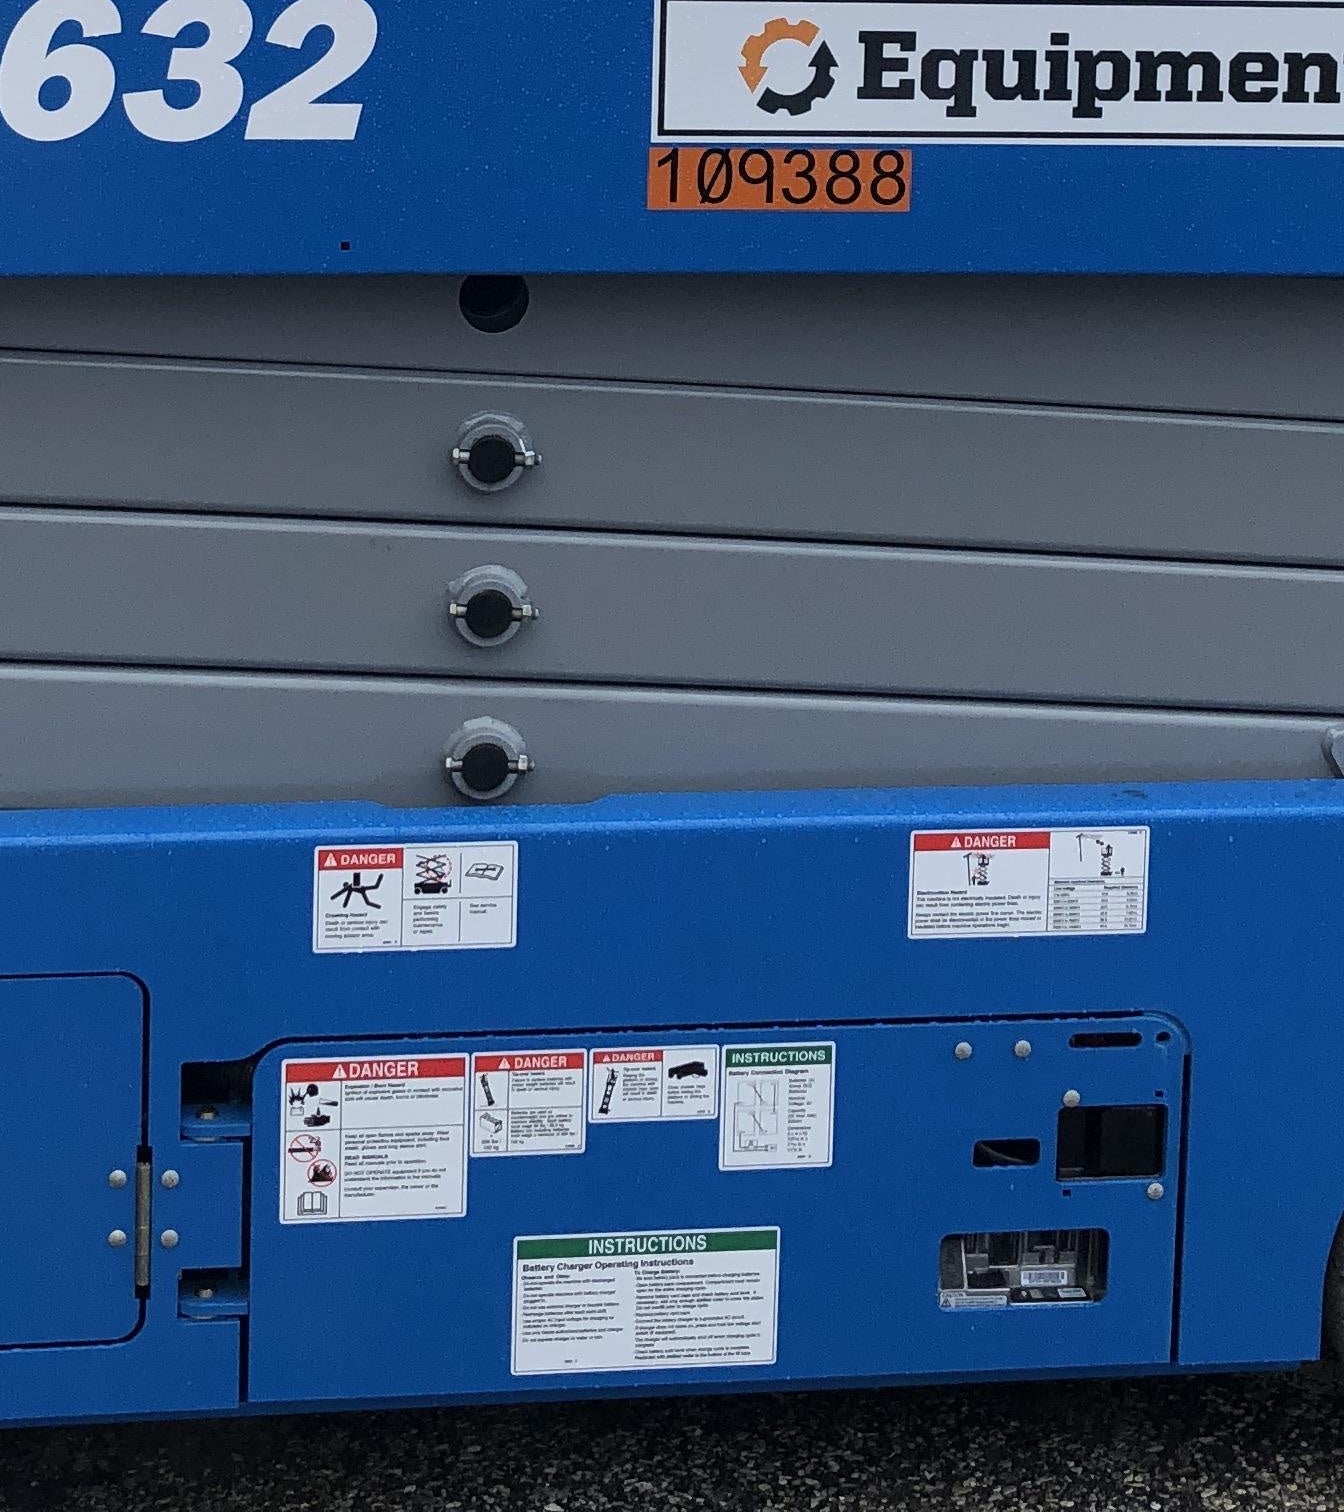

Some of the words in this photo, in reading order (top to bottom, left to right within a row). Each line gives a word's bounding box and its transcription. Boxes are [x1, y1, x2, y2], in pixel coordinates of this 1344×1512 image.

[655, 148, 909, 206] 109388
[964, 835, 1017, 848] DANGER
[340, 853, 396, 865] DANGER
[514, 1055, 567, 1069] DANGER
[612, 1052, 655, 1062] DANGER
[731, 1049, 826, 1064] INSTRUCTIONS
[349, 1061, 419, 1078] DANGER
[588, 1234, 707, 1255] INSTRUCTIONS
[522, 1263, 555, 1273] Battery
[556, 1262, 593, 1272] Charger
[594, 1260, 639, 1270] Operating
[640, 1258, 694, 1267] Instructions
